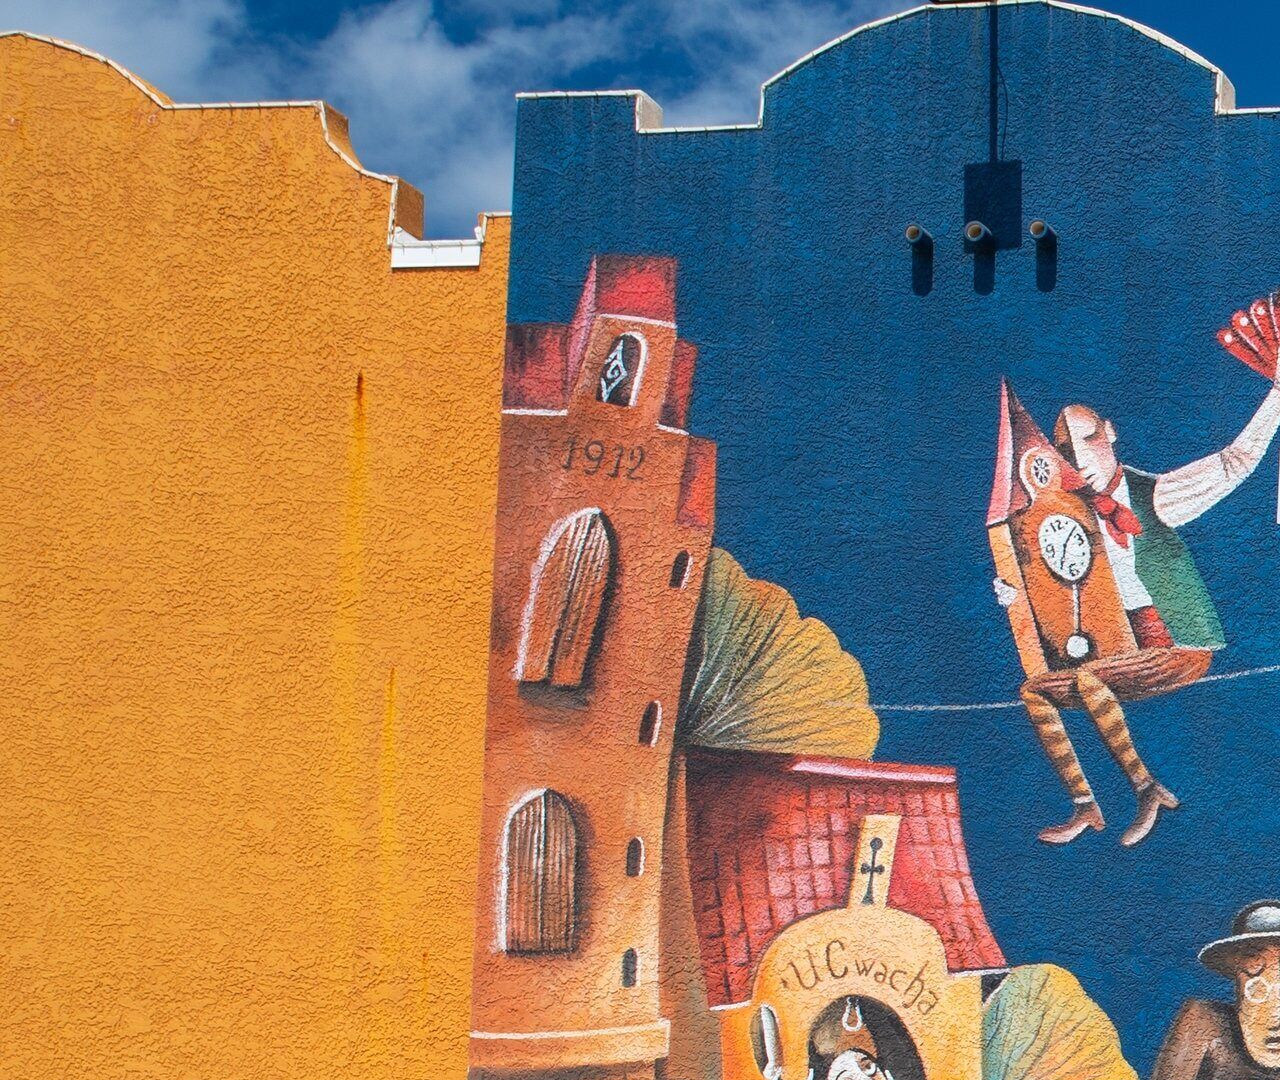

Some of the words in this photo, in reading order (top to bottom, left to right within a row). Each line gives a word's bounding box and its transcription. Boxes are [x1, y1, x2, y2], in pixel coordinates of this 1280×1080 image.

[560, 436, 645, 480] 1912
[1049, 519, 1064, 533] 12
[1074, 533, 1084, 546] 3
[1045, 543, 1056, 558] 9
[1069, 562, 1081, 577] 6
